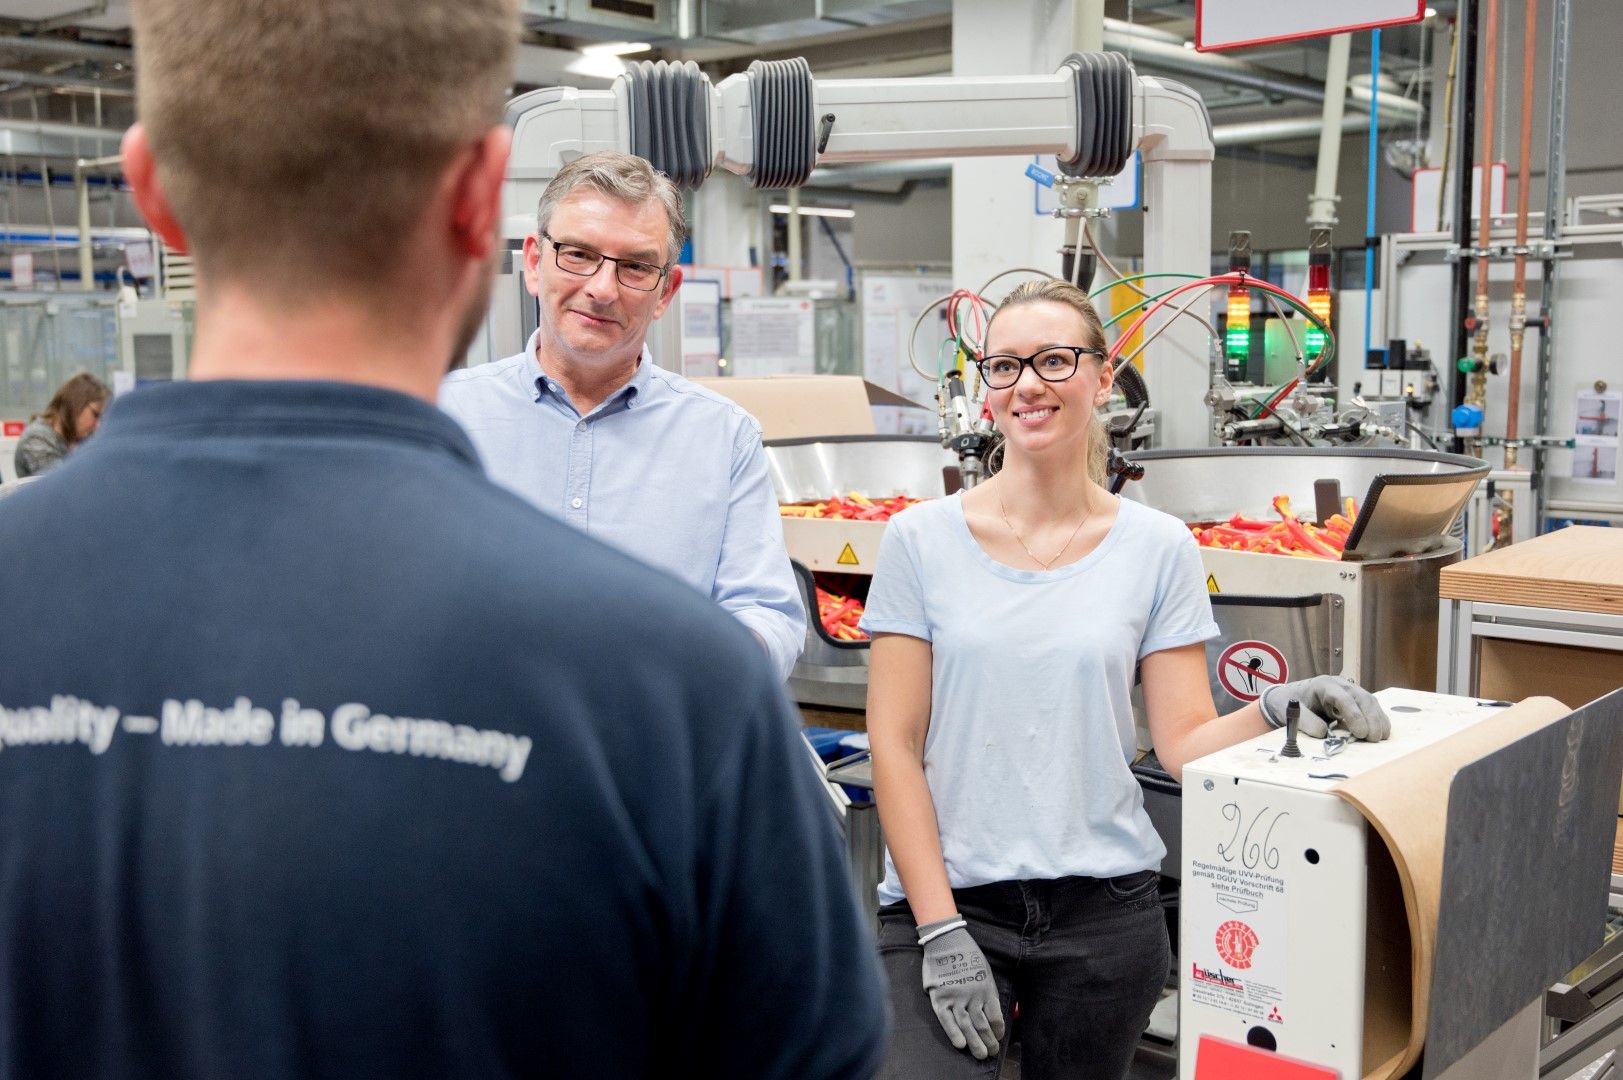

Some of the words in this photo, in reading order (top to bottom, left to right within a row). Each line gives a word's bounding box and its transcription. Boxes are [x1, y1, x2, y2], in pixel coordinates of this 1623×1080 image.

[161, 696, 275, 747] Made
[279, 697, 325, 748] in
[331, 702, 533, 783] Germany
[1217, 801, 1290, 870] 266
[1192, 860, 1236, 875] Regelmäßige
[1239, 870, 1284, 886] UVV-Prüfung
[1192, 870, 1215, 879] gemäß
[1217, 874, 1238, 883] DGUV
[1240, 877, 1274, 892] Vorschrift
[1211, 882, 1230, 891] siehe
[1231, 885, 1264, 899] Prüfbuch
